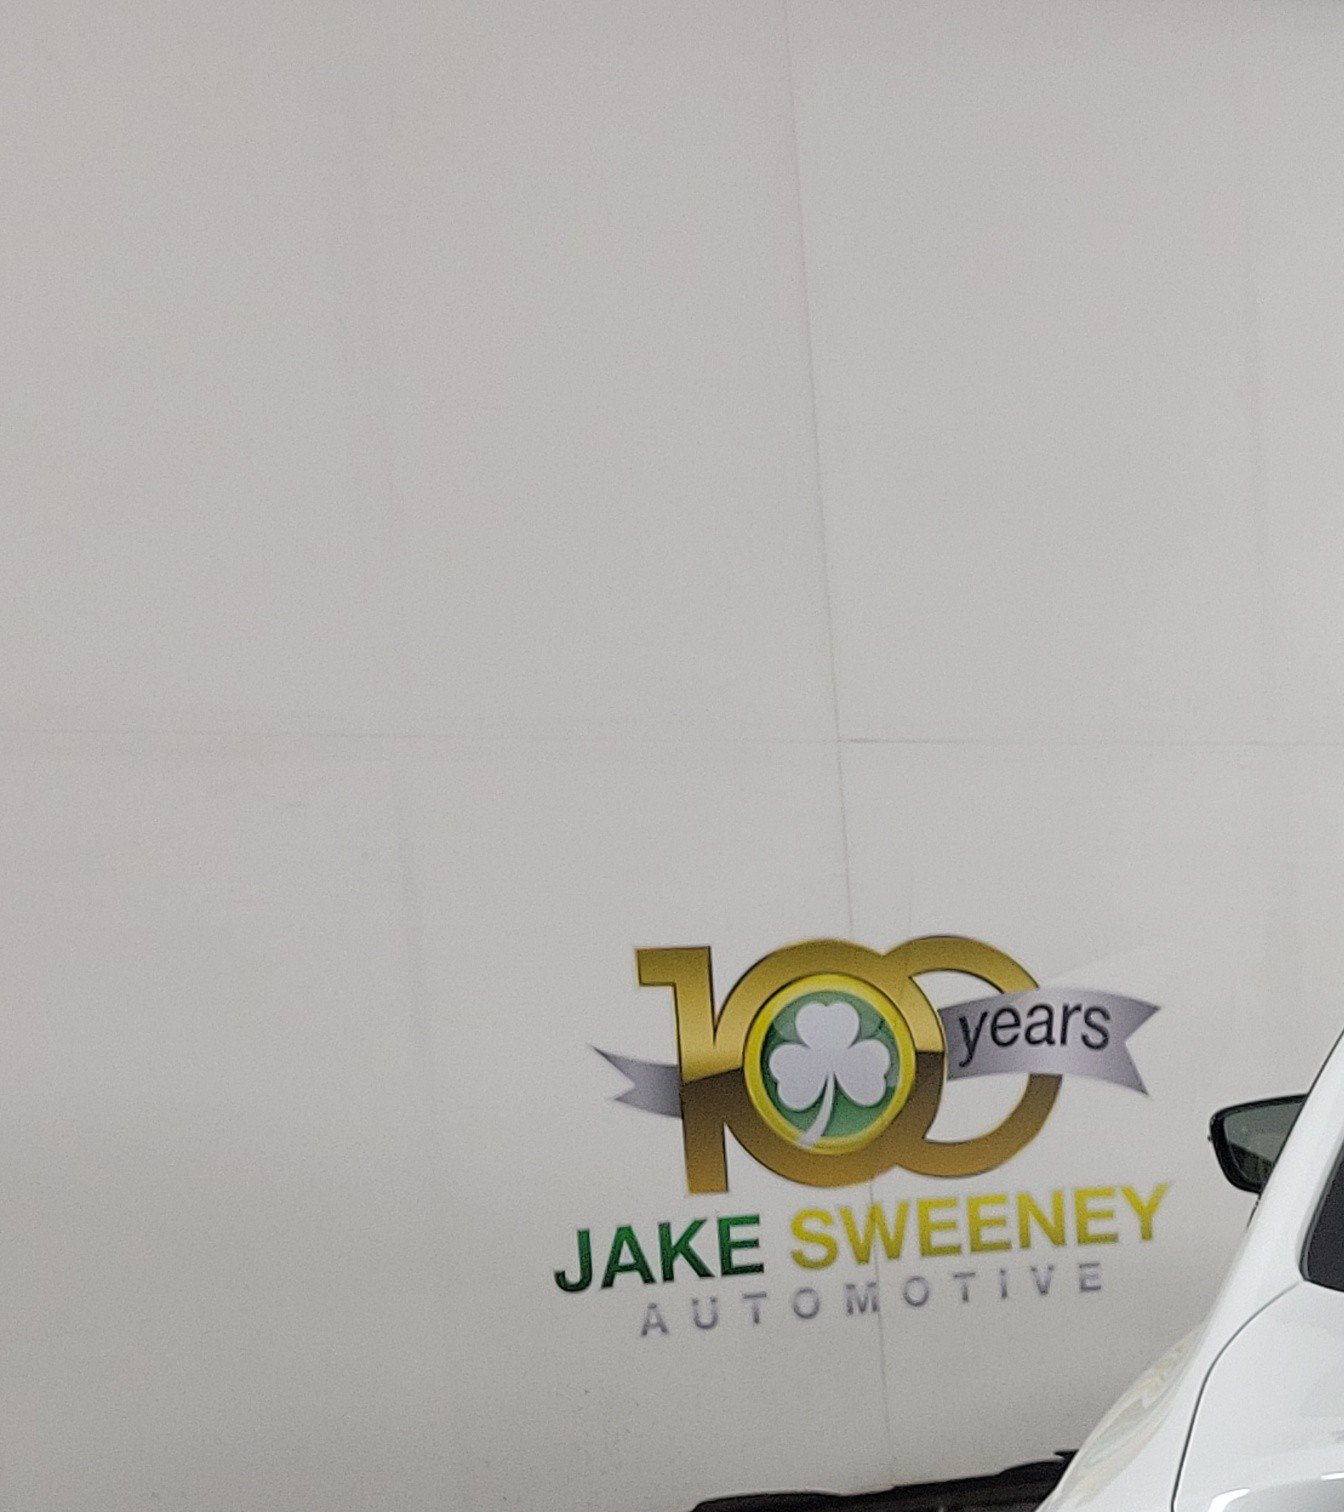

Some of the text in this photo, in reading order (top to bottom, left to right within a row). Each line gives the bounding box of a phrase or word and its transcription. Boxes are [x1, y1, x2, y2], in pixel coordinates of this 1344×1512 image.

[958, 1001, 1112, 1069] years
[553, 1184, 1171, 1294] JAKE SWEENEY
[640, 1262, 1103, 1337] AUTOMOTIVE
